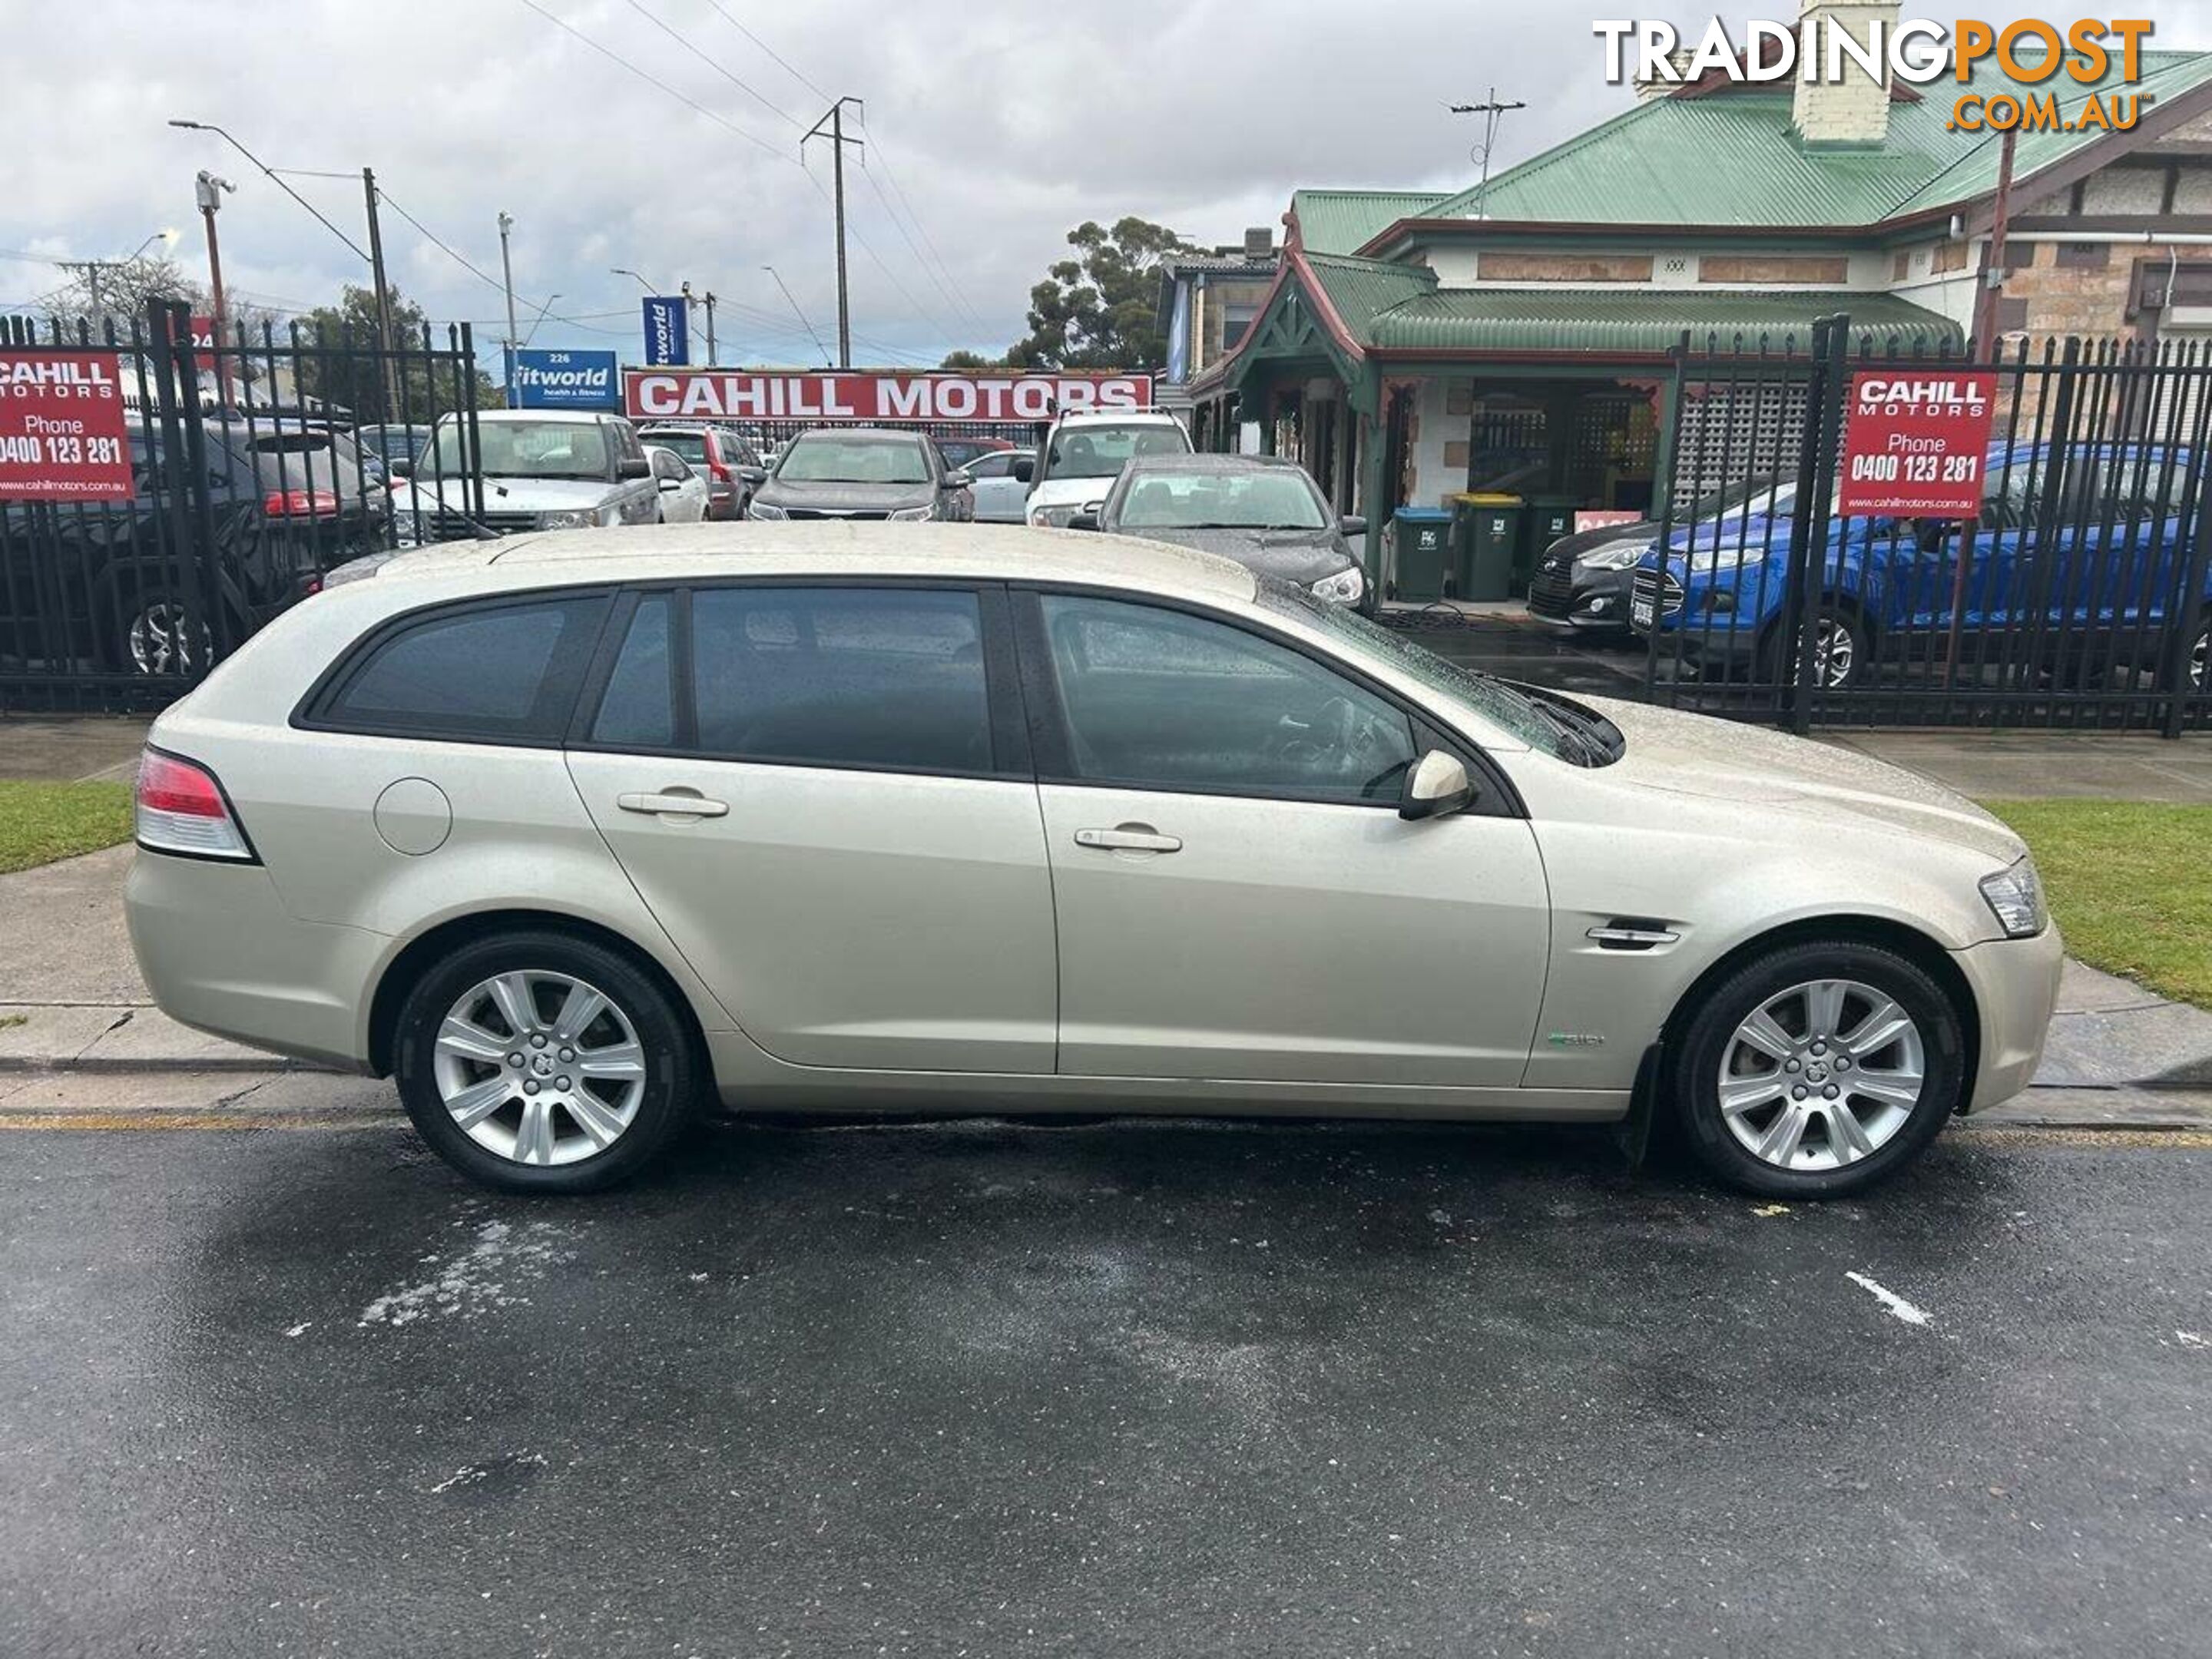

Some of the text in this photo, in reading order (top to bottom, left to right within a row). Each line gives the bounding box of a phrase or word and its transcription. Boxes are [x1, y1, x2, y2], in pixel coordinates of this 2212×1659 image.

[652, 304, 668, 364] tworld
[550, 353, 571, 363] 226
[639, 376, 1136, 418] CAHILL MOTORS
[1860, 380, 1986, 403] CAHILL
[1858, 404, 1983, 416] MOTORS
[25, 415, 84, 434] Phone
[46, 436, 81, 463] 123
[87, 437, 121, 464] 281
[1888, 433, 1946, 452] Phone
[1851, 454, 1978, 482] 0400 123 281
[0, 480, 125, 491] www.cahillmotors.com.au
[1848, 497, 1973, 508] www.cahillmotors.com.au
